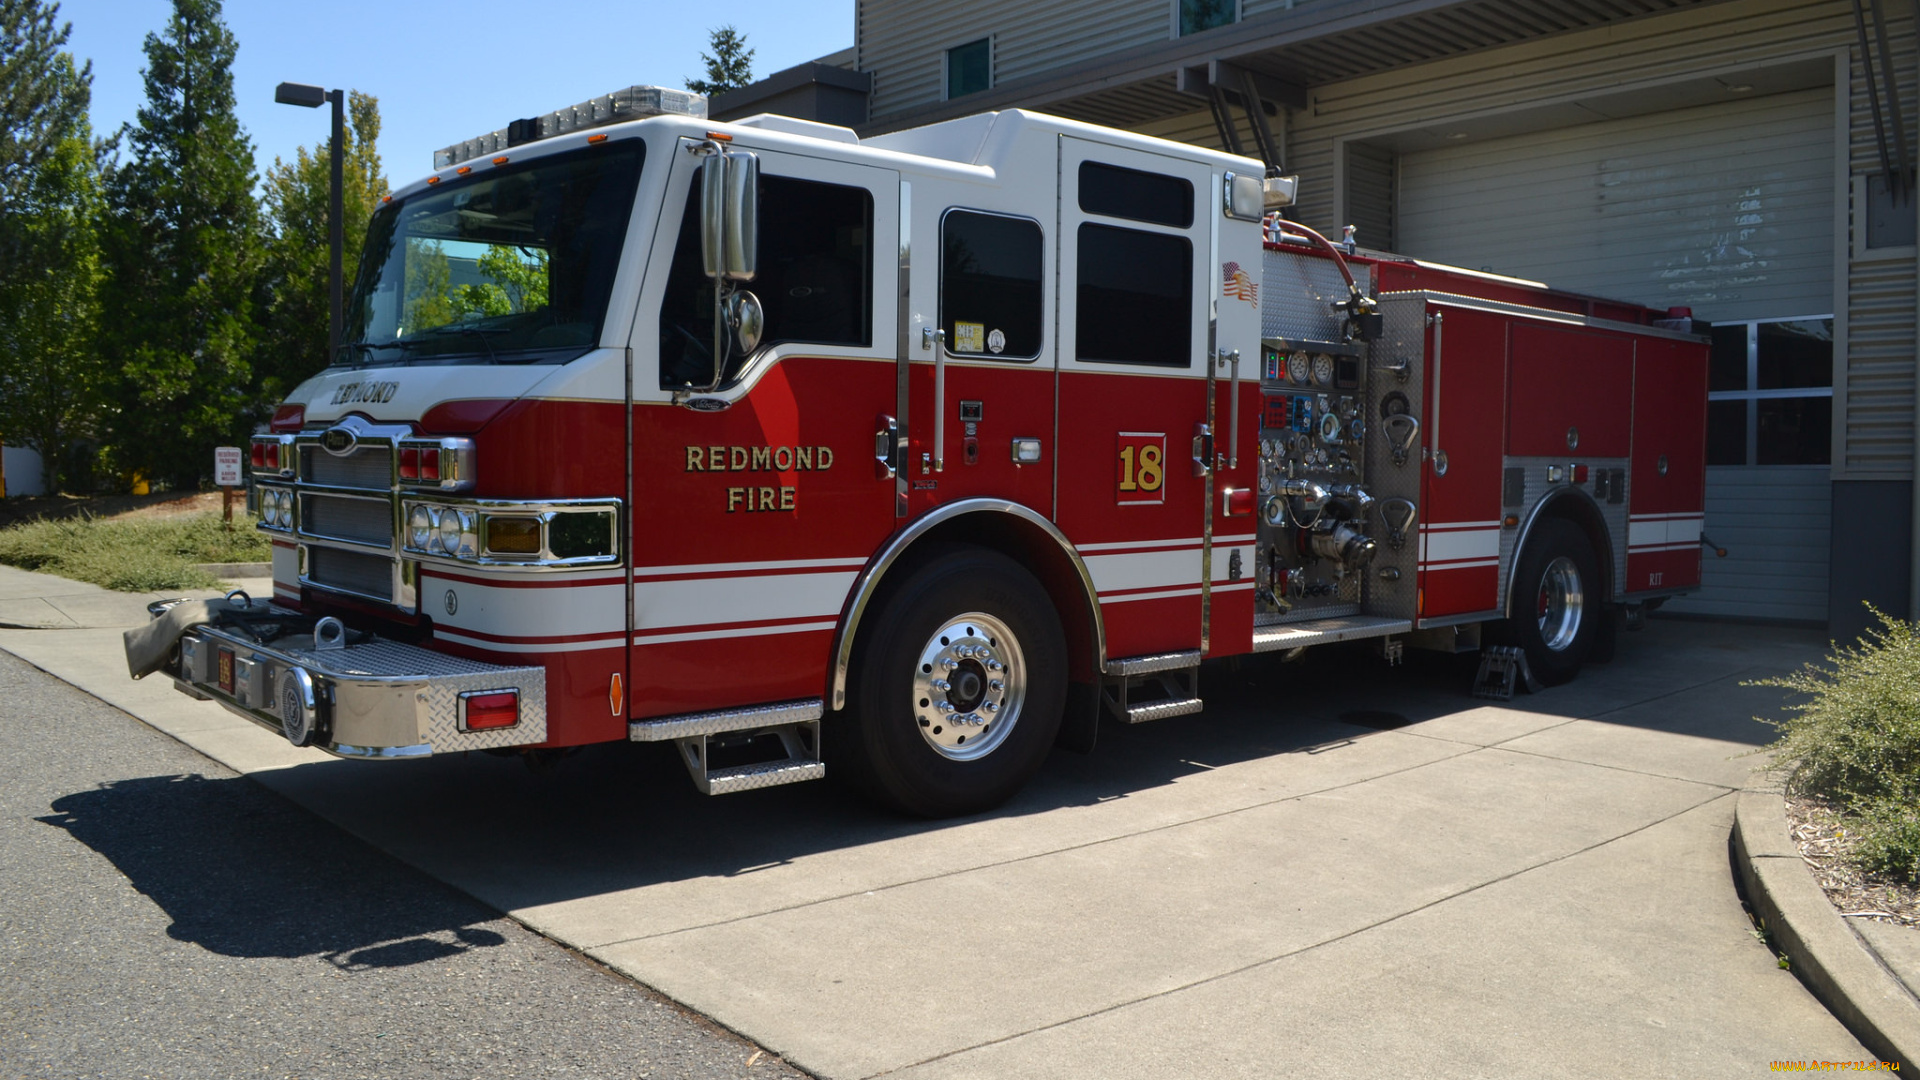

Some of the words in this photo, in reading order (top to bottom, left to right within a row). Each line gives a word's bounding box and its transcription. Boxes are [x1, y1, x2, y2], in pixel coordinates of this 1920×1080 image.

[685, 446, 834, 472] REDMOND
[1120, 445, 1163, 493] 18
[727, 486, 796, 512] FIRE
[1649, 572, 1663, 586] RIT
[219, 658, 230, 684] 18
